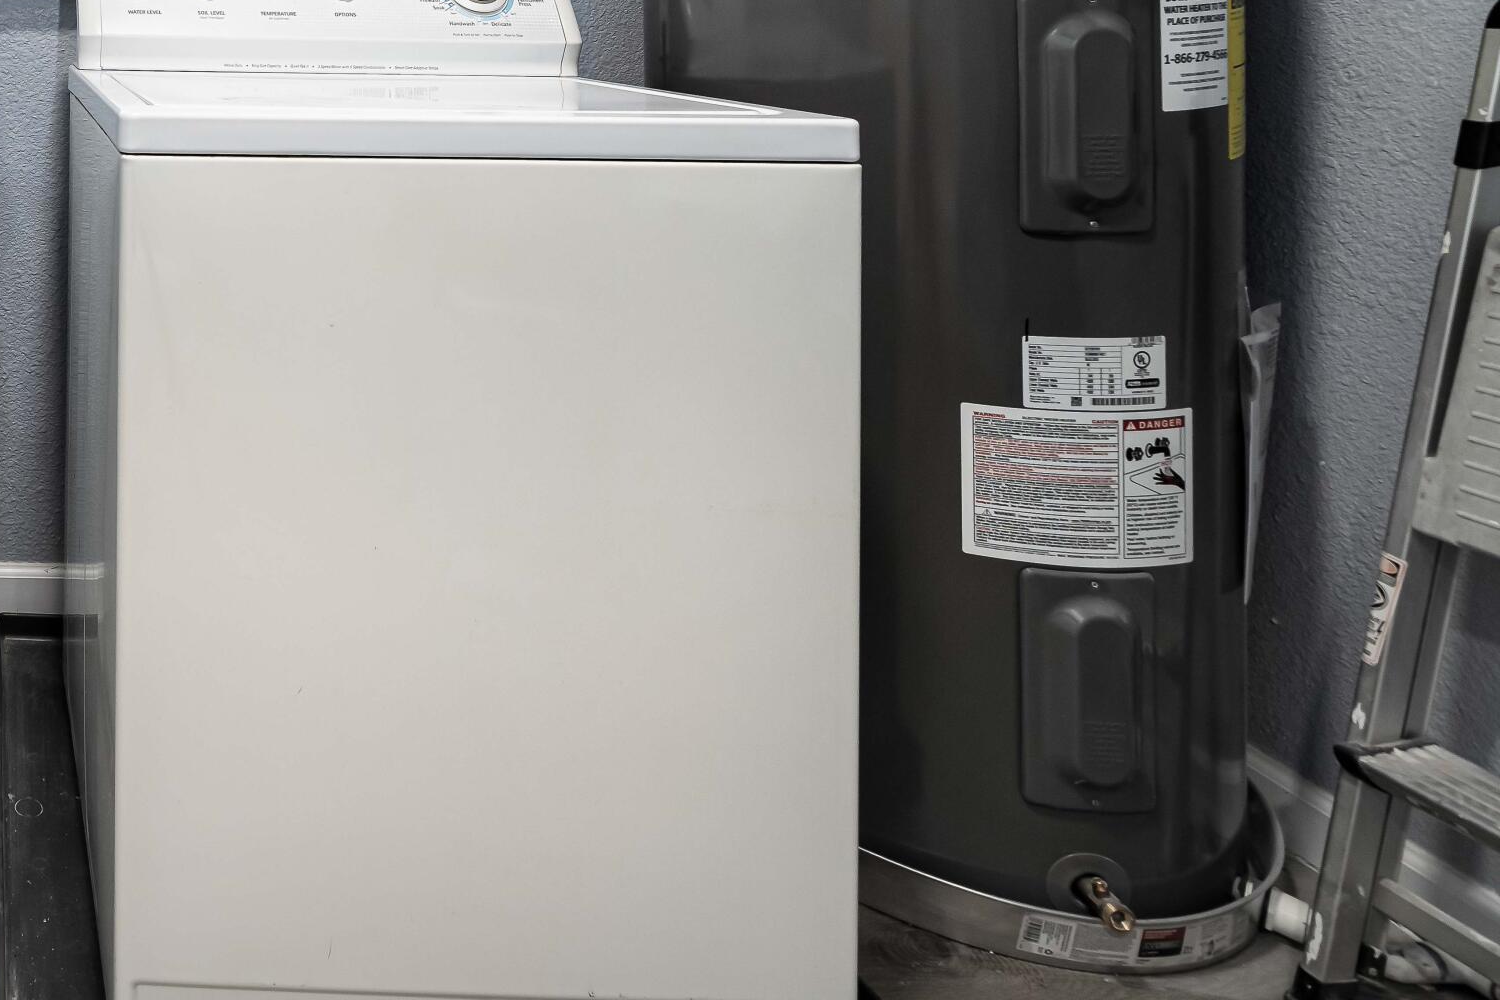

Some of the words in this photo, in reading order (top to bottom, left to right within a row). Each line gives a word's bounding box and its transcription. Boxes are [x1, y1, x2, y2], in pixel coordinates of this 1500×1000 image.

[1164, 5, 1188, 14] WATER
[1189, 4, 1210, 13] HEATER
[1167, 16, 1189, 26] PLACE
[1190, 16, 1199, 24] OF
[973, 411, 1005, 419] WARNING
[1139, 418, 1182, 429] DANGER
